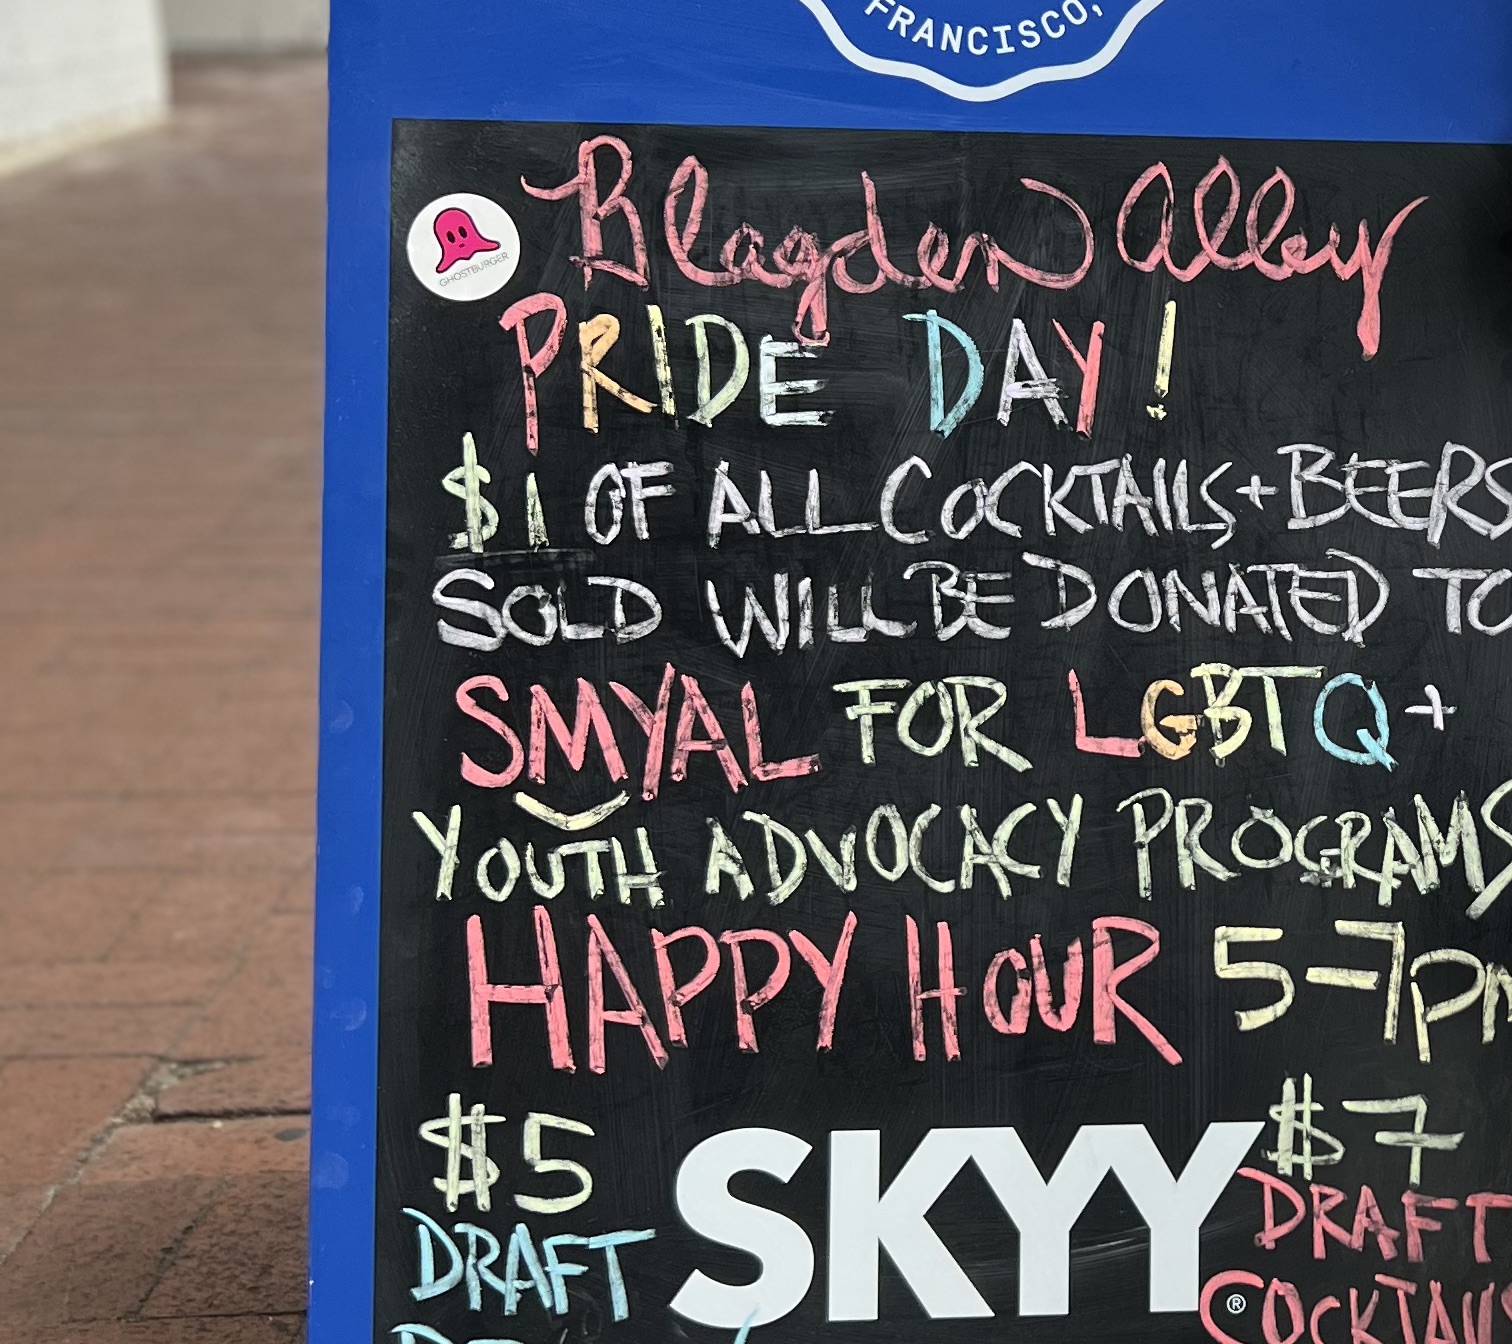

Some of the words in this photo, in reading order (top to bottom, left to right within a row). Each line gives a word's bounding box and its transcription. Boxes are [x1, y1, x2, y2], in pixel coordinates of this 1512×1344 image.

[439, 251, 509, 287] GHOSTBURGER
[499, 292, 835, 456] PRIDE
[442, 432, 548, 553] $1
[584, 461, 675, 545] OF
[706, 458, 879, 549] ALL
[432, 568, 663, 652] SOLD
[706, 570, 917, 657] WILL
[903, 560, 1014, 641] BE
[1022, 547, 1391, 648] DONATED
[456, 662, 822, 800] SMYAL
[832, 675, 1034, 773] FOR
[412, 804, 667, 908] YOUTH
[704, 793, 1084, 906] ADVOCACY
[466, 904, 858, 1075] HAPPY
[905, 913, 1184, 1066] HOUR
[418, 1092, 595, 1215] $5
[1261, 1072, 1466, 1189] $7
[402, 1207, 656, 1322] DRAFT
